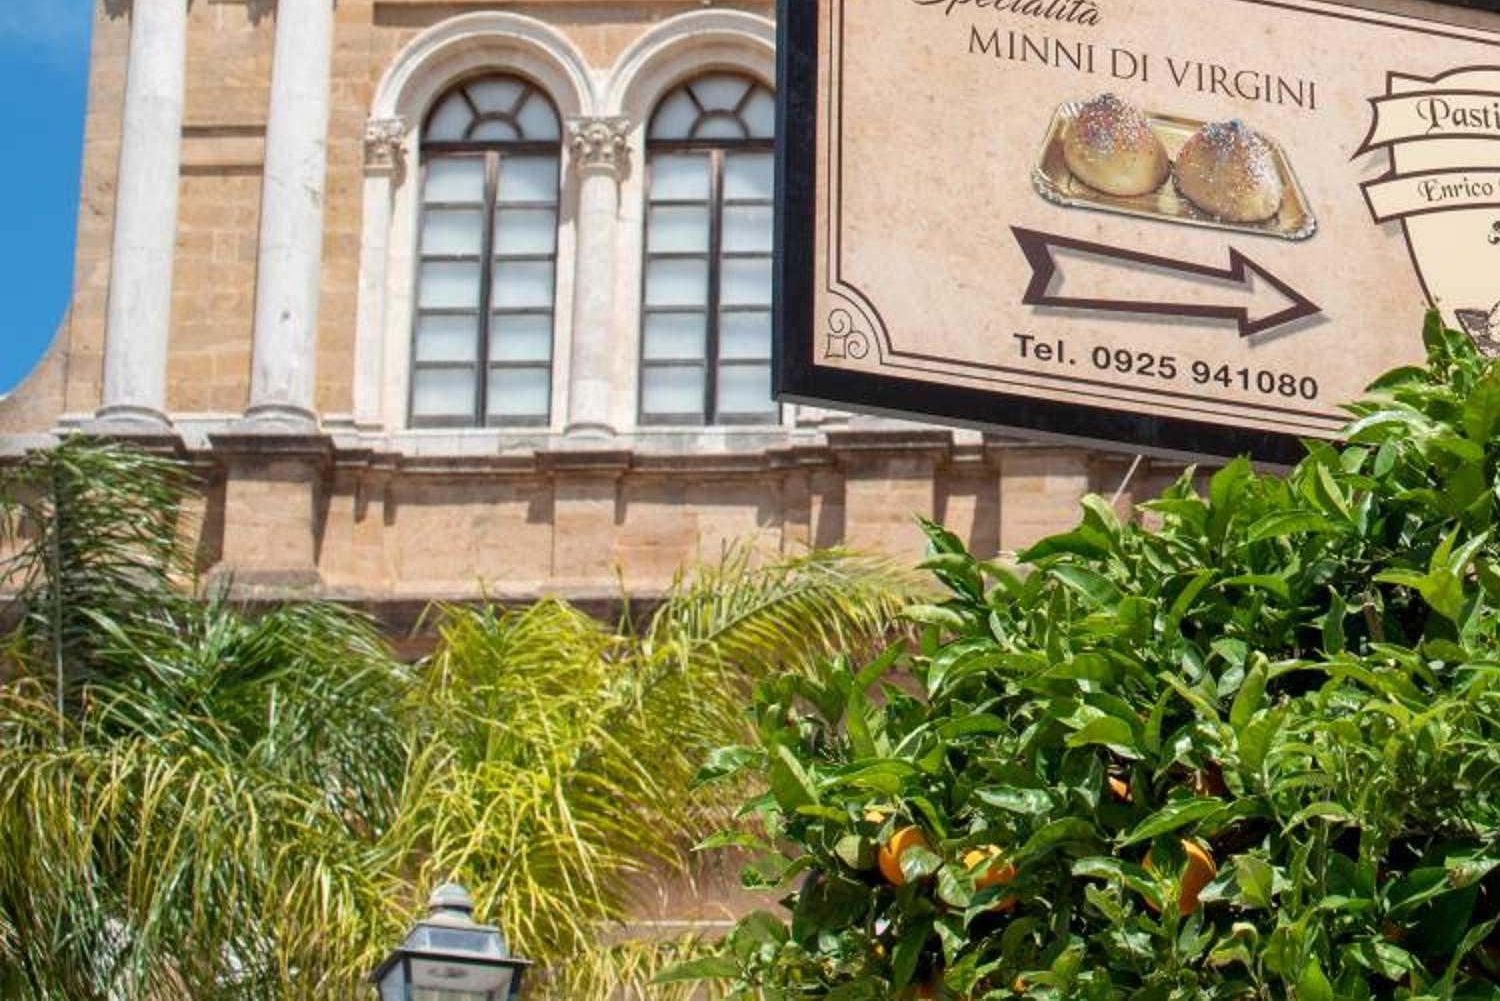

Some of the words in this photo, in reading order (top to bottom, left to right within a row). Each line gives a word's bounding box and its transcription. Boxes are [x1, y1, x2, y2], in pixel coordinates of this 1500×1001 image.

[968, 24, 1097, 74] MINNI
[1110, 48, 1149, 83] DI
[1167, 57, 1316, 111] VIRGINI
[1418, 176, 1494, 202] Enrico
[1013, 332, 1076, 366] Tel.
[1091, 346, 1178, 380] 0925
[1191, 360, 1319, 400] 941080
